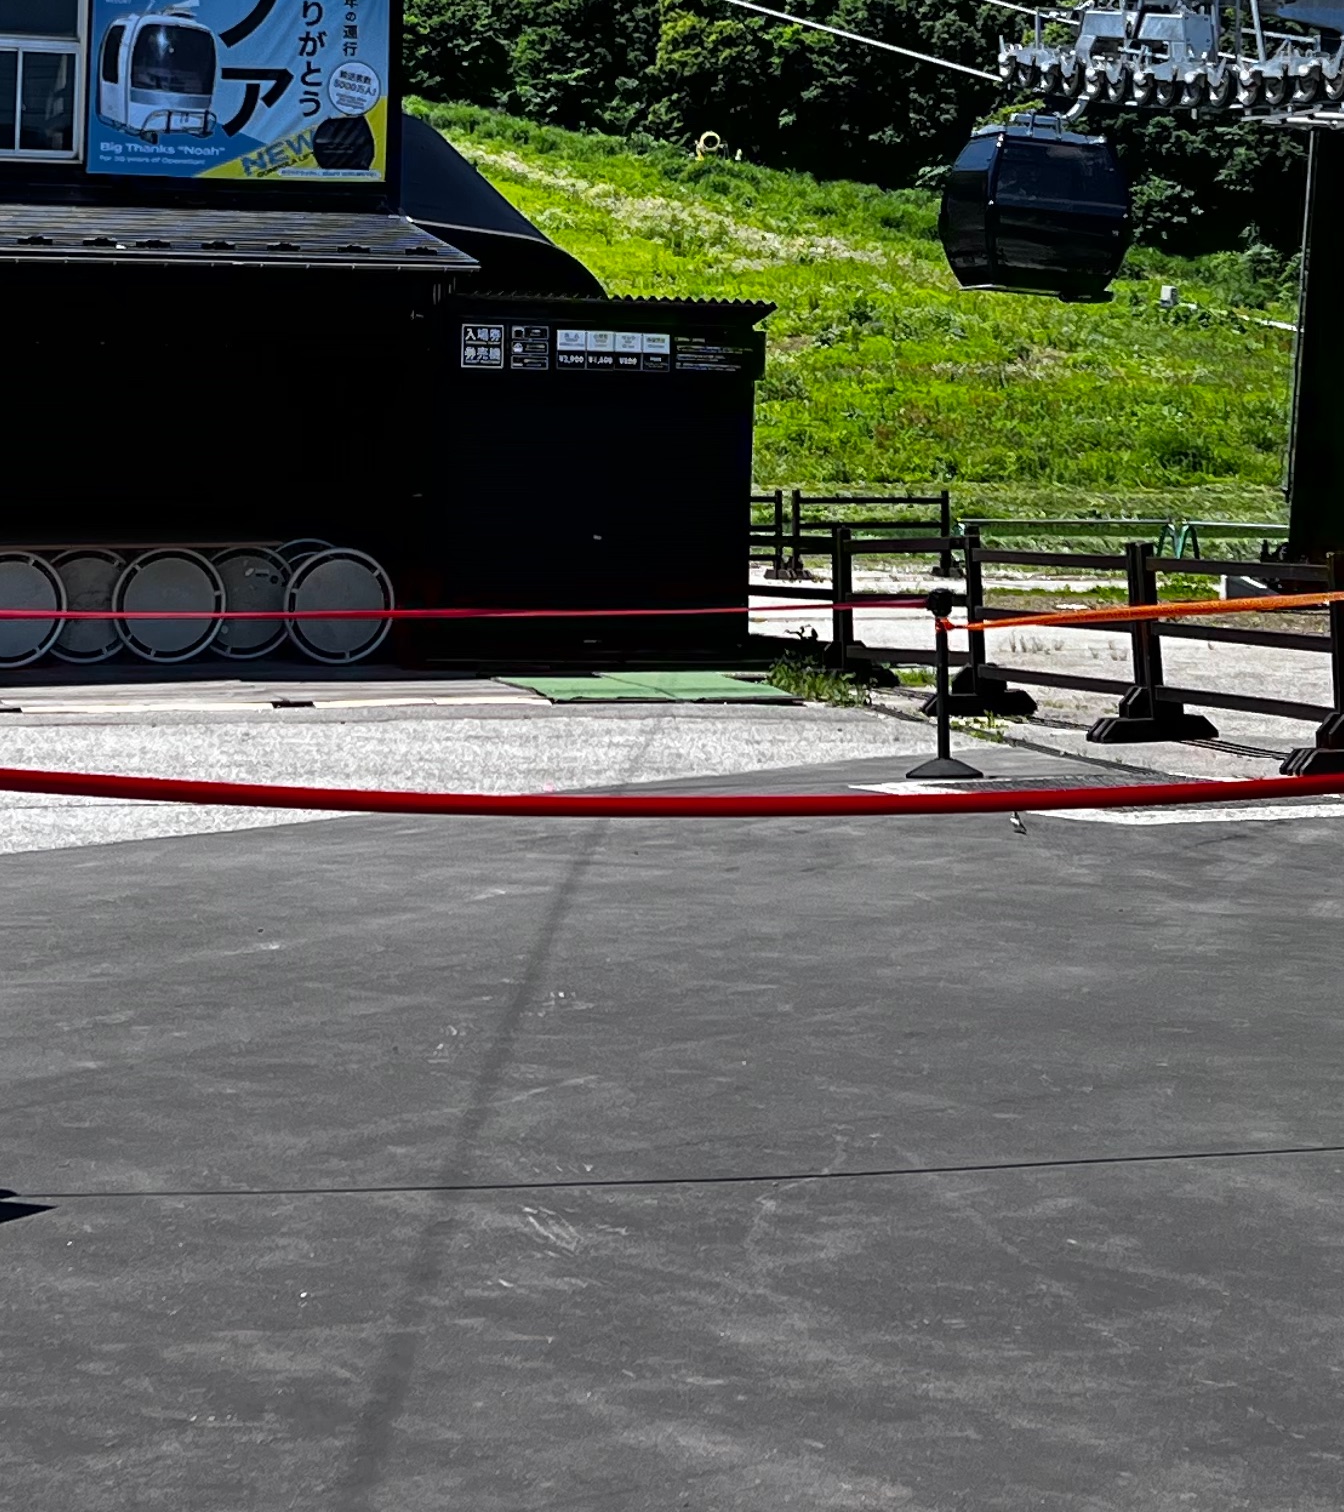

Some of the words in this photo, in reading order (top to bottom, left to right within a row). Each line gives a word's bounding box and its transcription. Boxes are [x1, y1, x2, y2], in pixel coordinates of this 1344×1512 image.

[100, 142, 123, 154] Big
[125, 142, 175, 155] Thanks
[240, 128, 315, 176] NEW
